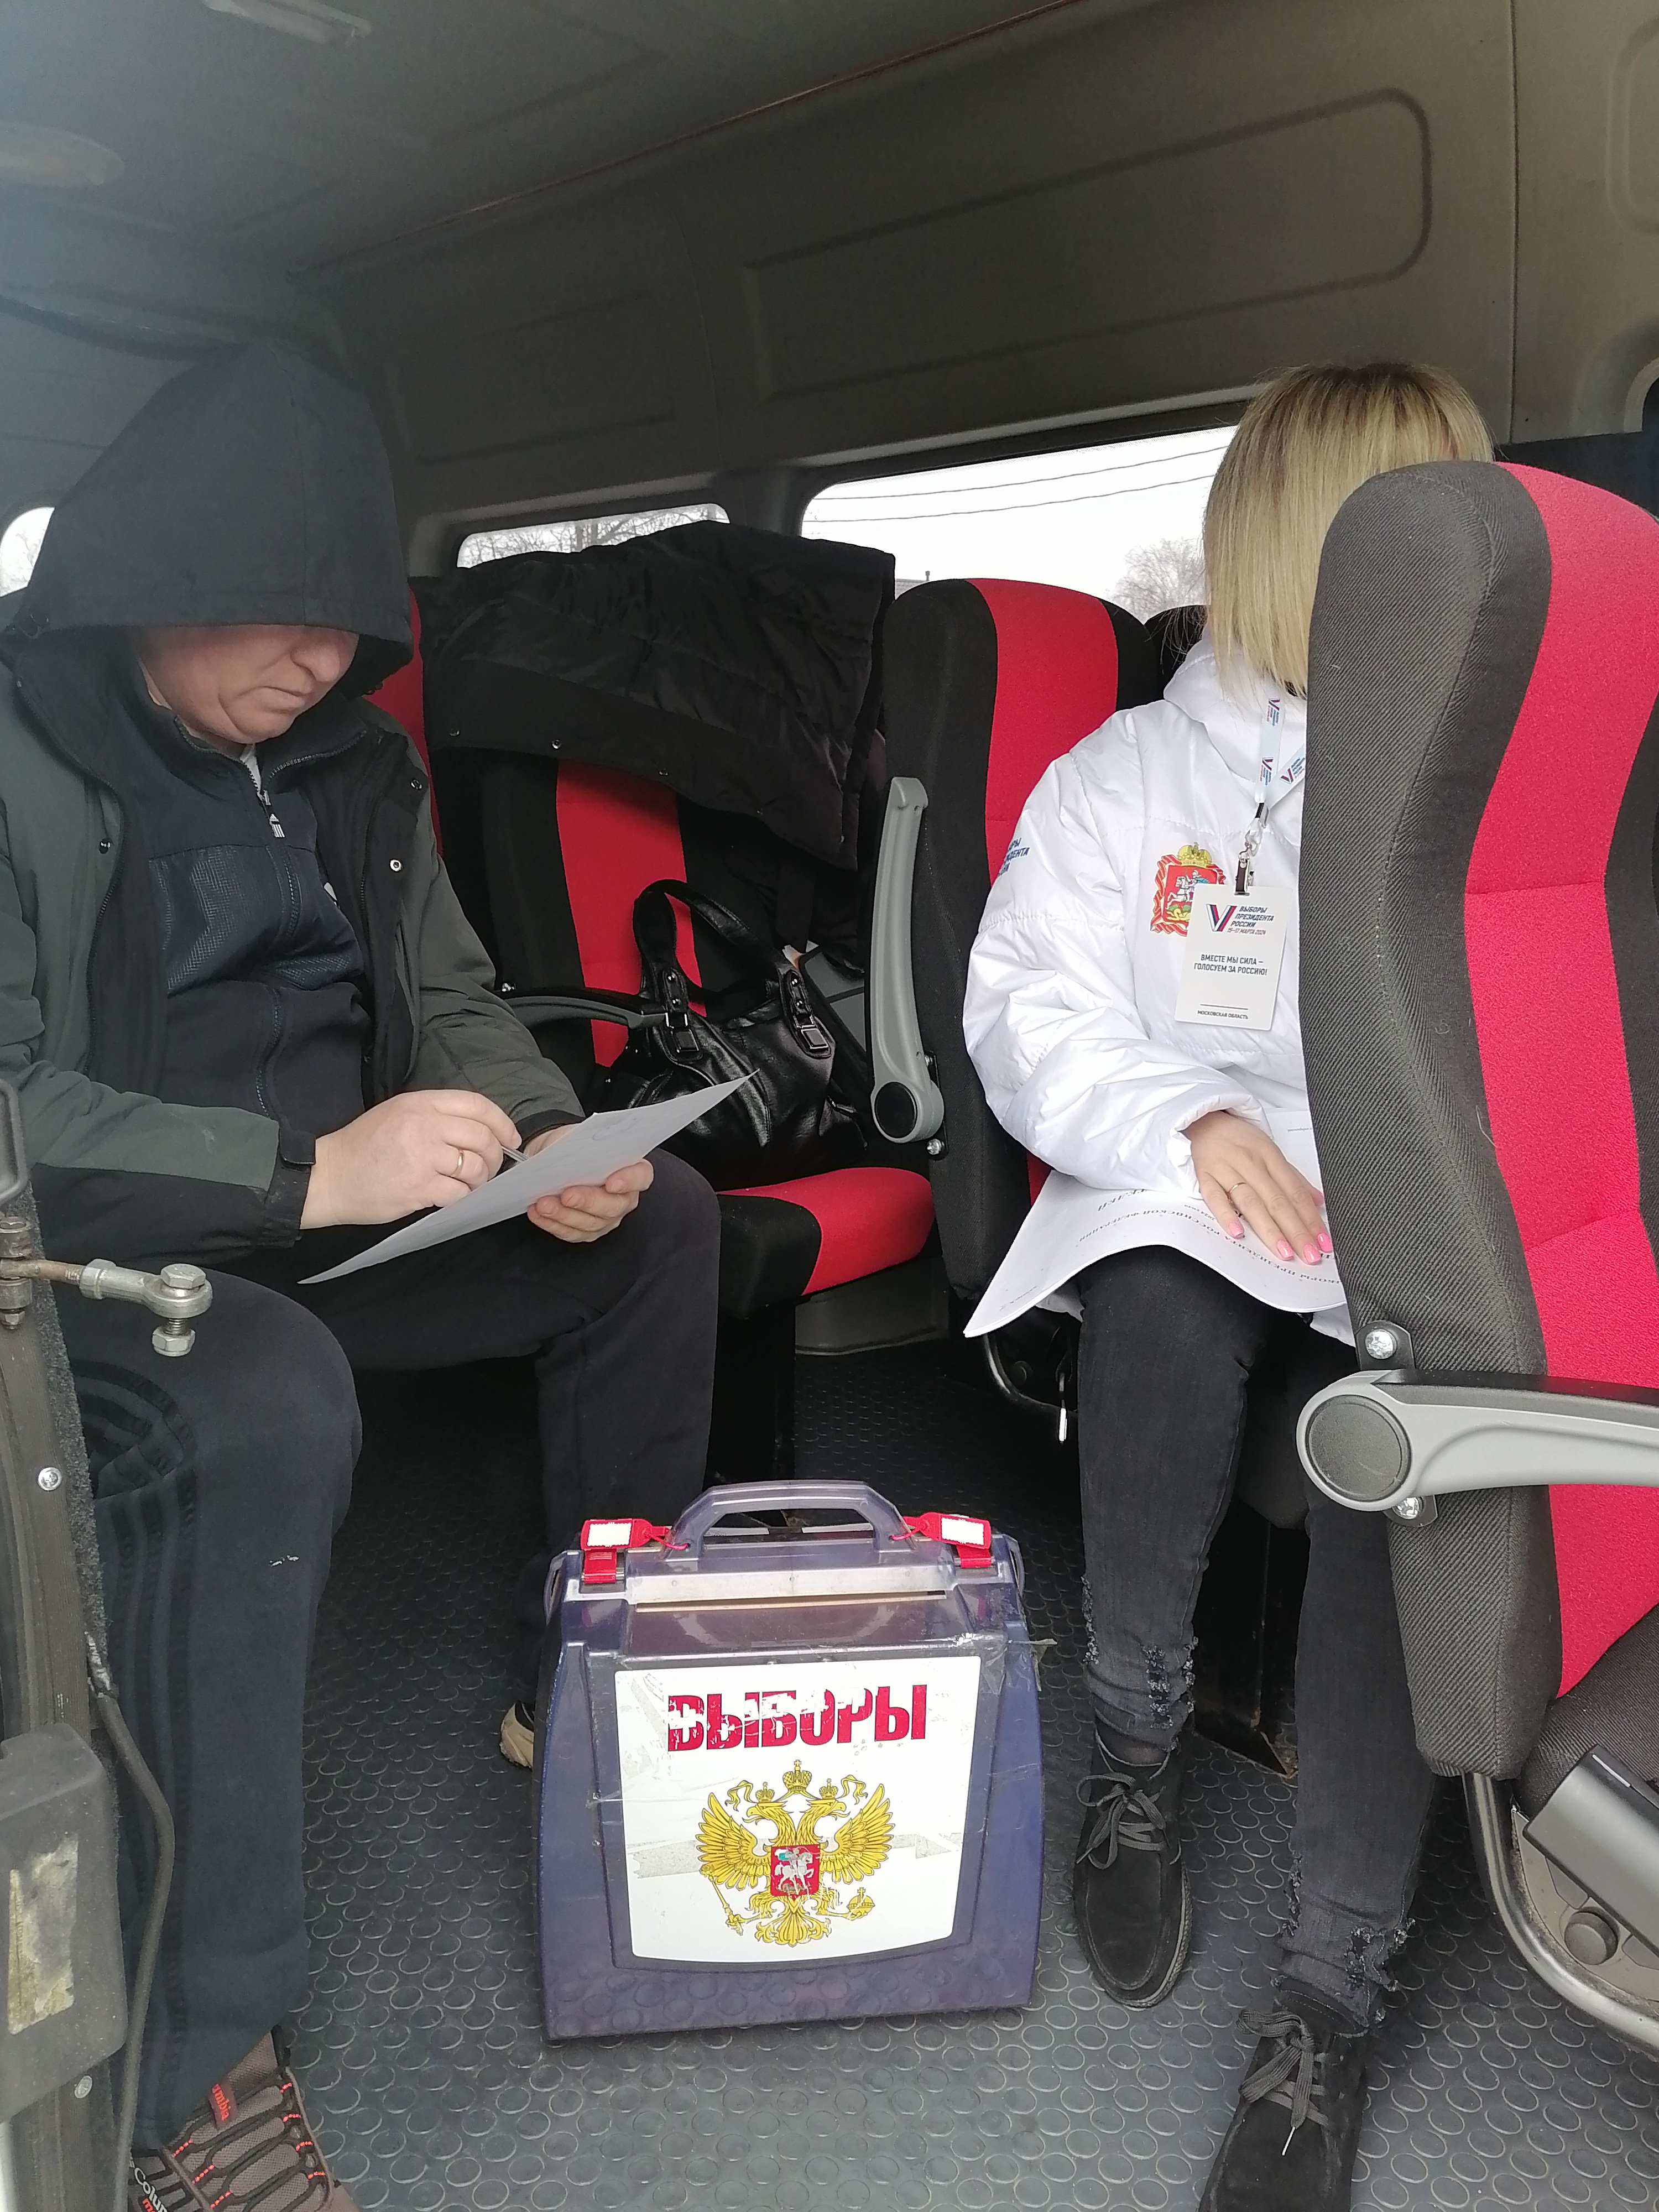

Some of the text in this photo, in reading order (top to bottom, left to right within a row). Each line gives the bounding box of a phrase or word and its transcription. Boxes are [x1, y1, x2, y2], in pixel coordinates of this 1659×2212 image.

[1004, 847, 1030, 865] ДЕНТА
[1234, 914, 1274, 922] ПРЕЗИДЕНТА
[1201, 954, 1226, 963] ВМЕСТЕ
[1194, 963, 1227, 972] ГОЛОСУЕМ
[1237, 966, 1267, 975] РОССИЮ!
[667, 1684, 927, 1752] ВЫБОРЫ
